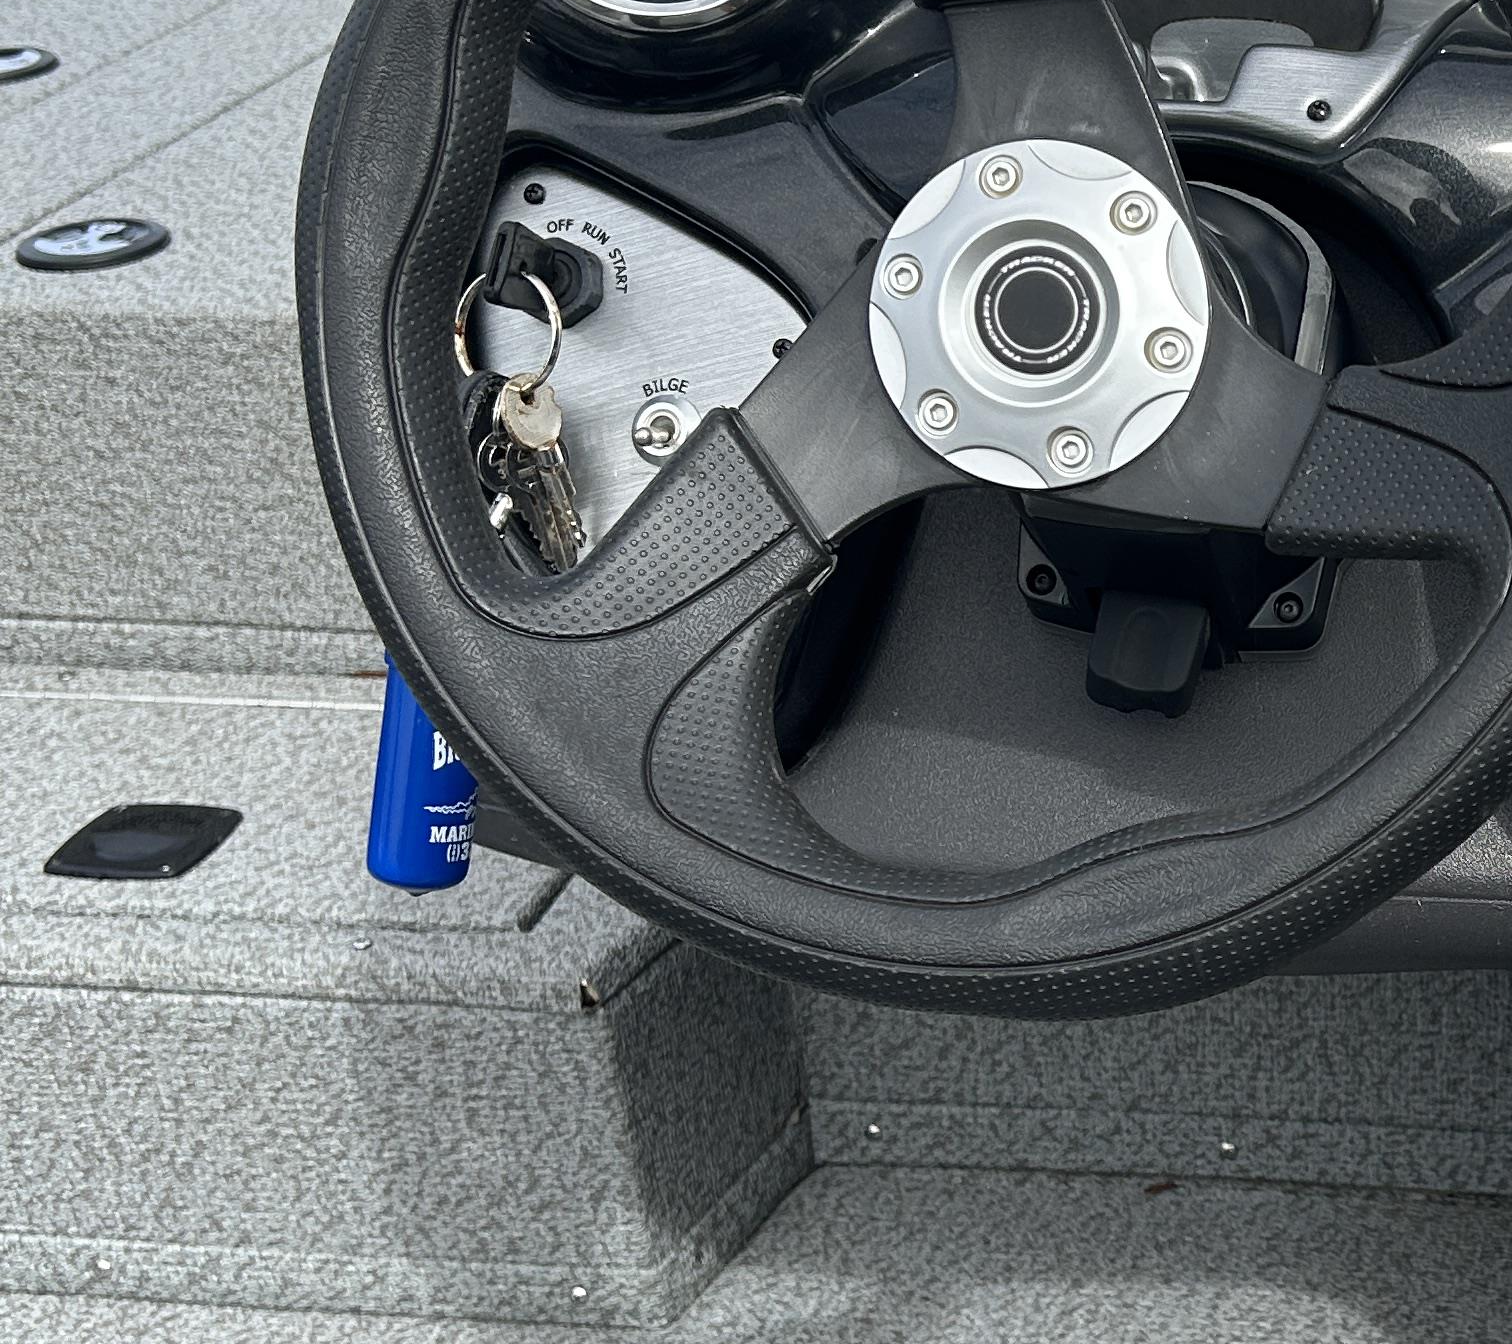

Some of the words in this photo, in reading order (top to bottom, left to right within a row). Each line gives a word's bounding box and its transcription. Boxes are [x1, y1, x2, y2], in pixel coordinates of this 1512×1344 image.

[546, 218, 575, 233] OFF
[581, 221, 611, 246] RUN
[608, 247, 628, 294] START
[642, 377, 690, 398] BILGE
